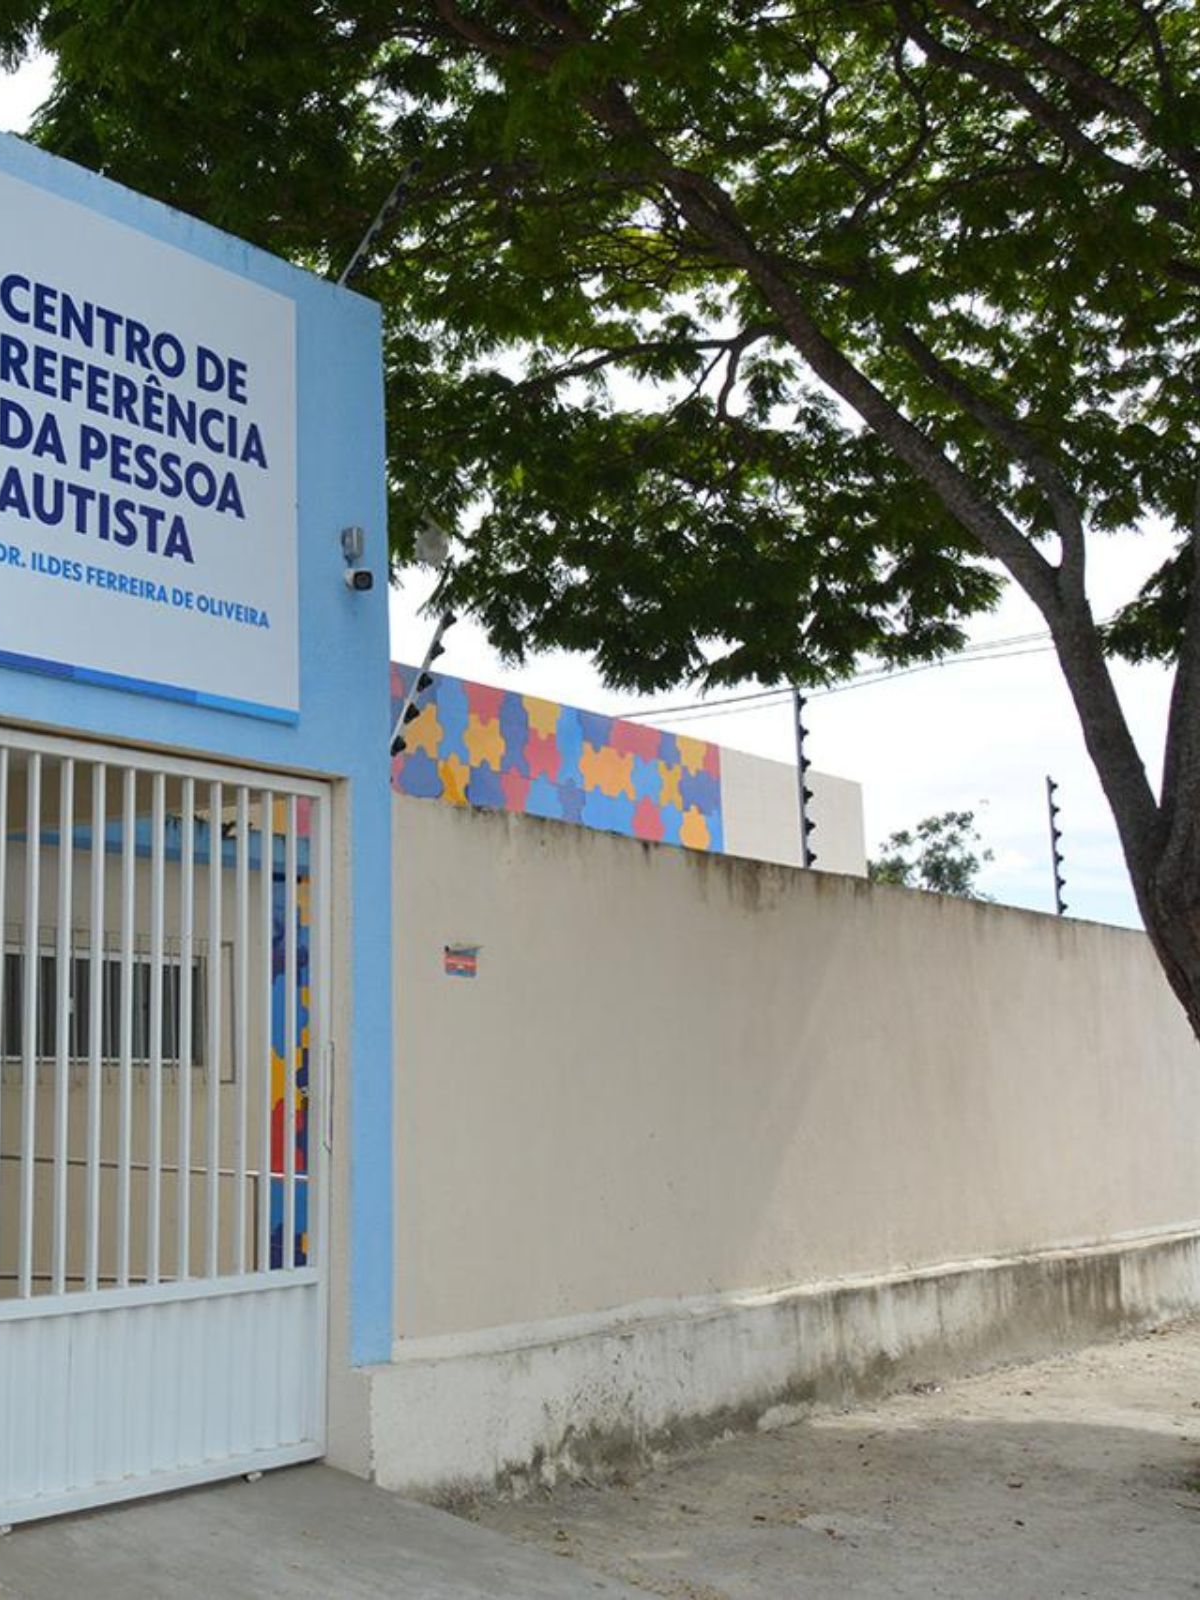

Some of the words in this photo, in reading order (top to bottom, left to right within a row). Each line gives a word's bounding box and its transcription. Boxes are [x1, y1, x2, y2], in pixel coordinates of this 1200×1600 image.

[0, 273, 186, 378] CENTRO
[197, 345, 247, 405] DE
[0, 332, 268, 469] REFERÊNCIA
[0, 397, 67, 465] DA
[80, 424, 245, 519] PESSOA
[31, 552, 82, 582] ILDES
[86, 568, 168, 604] FERREIRA
[172, 588, 193, 609] DE
[197, 595, 270, 629] OLIVEIRA
